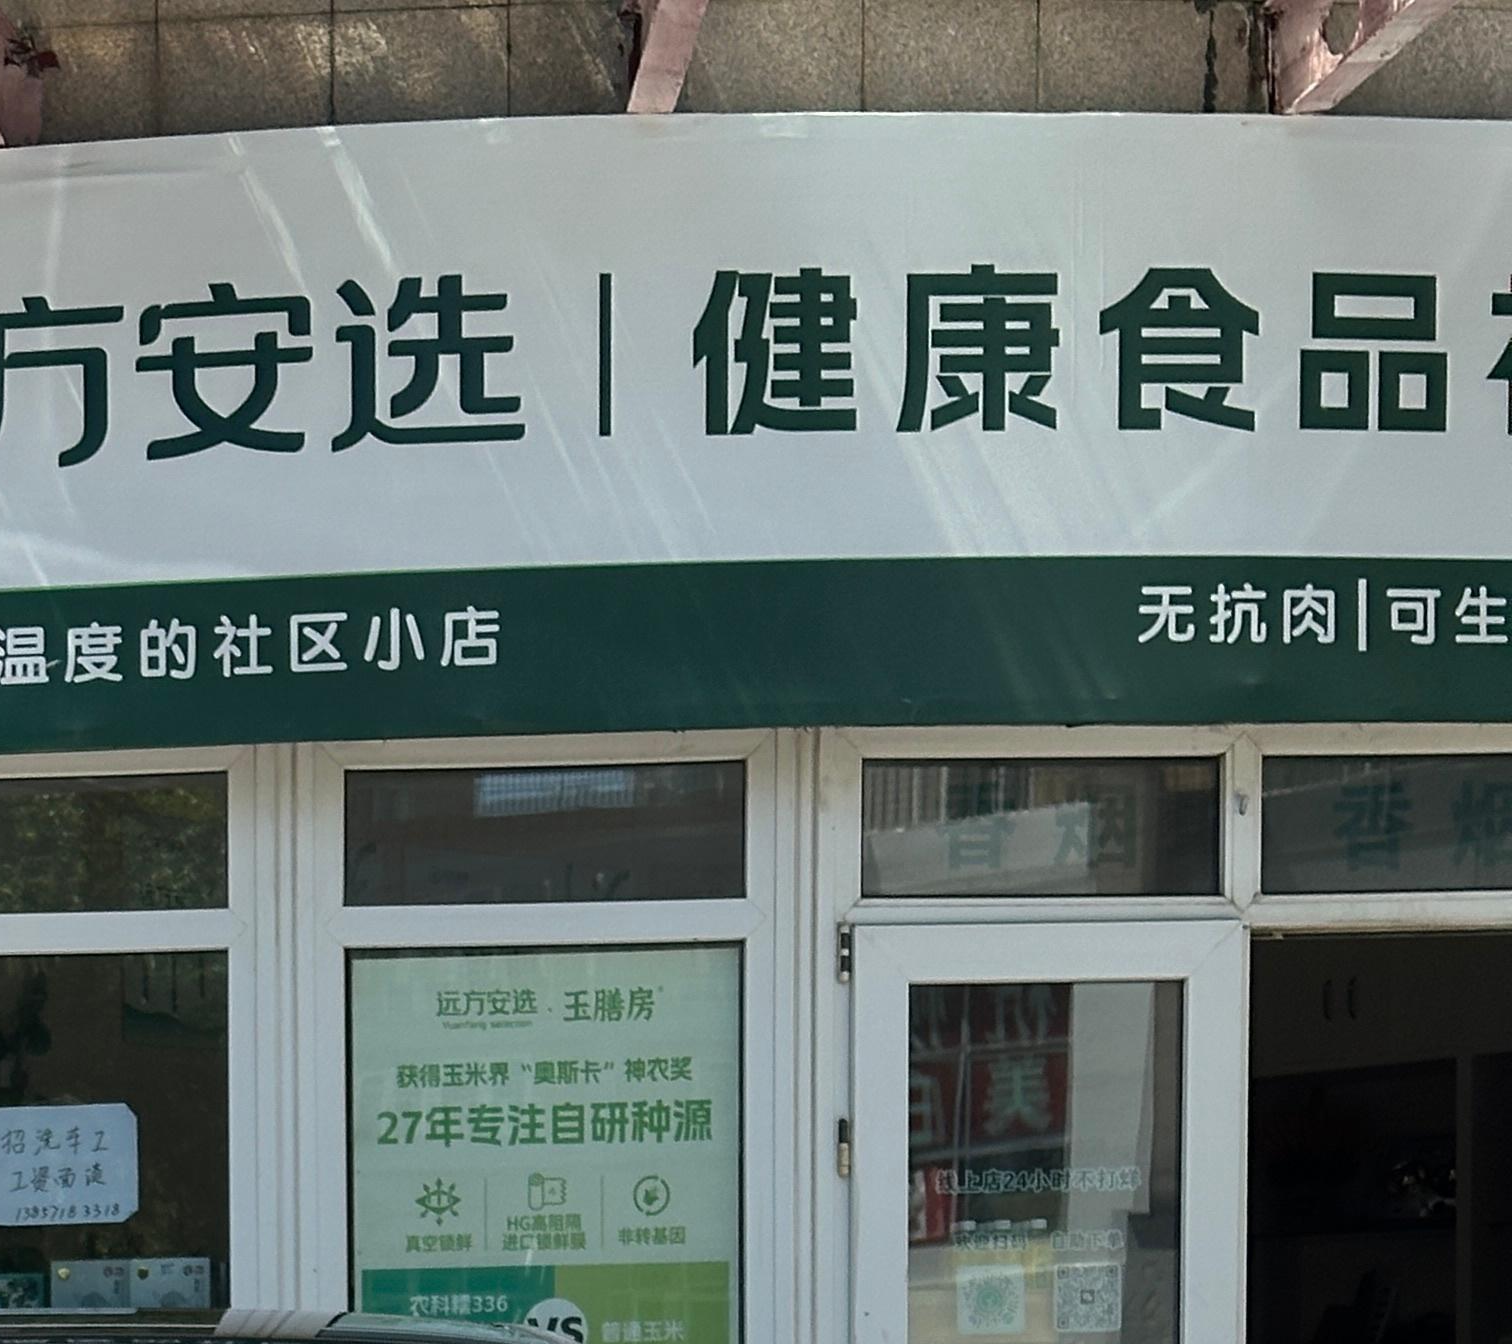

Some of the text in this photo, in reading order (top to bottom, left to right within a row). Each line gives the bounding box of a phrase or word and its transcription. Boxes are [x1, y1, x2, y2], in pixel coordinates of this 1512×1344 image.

[692, 264, 1512, 436] 健康食品
[436, 986, 656, 1023] 远方安选 玉膳房
[377, 1099, 713, 1148] 27年专注自研种源
[618, 1226, 686, 1246] 非转基因
